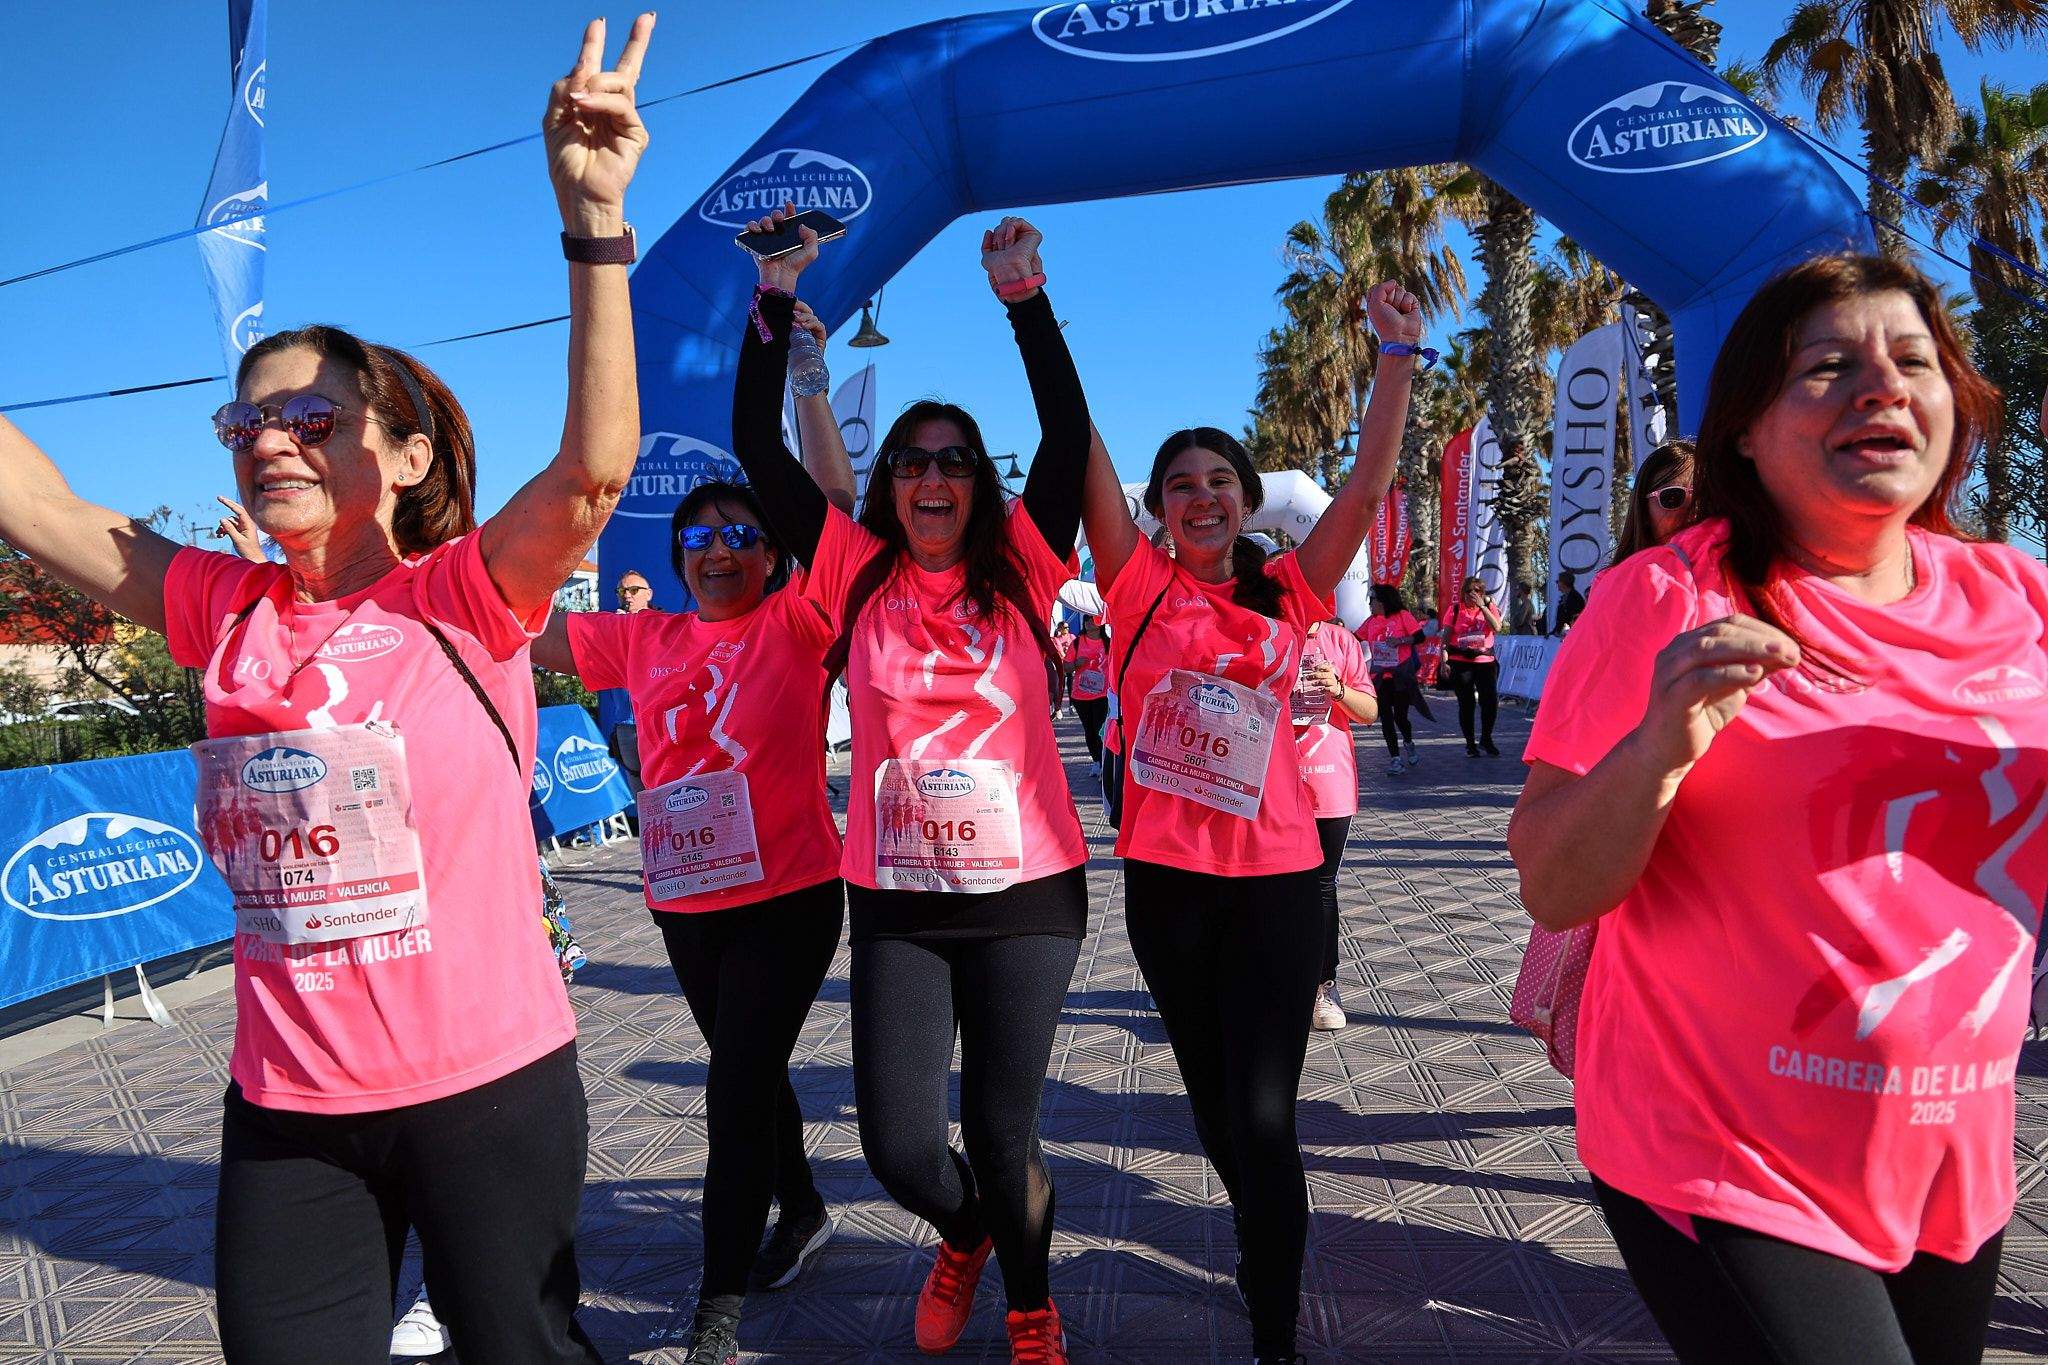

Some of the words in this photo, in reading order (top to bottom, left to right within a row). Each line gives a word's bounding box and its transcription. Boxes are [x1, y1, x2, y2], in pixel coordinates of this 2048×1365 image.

[1057, 0, 1303, 38] ASTUR
[1616, 109, 1682, 128] CENTRAL
[1688, 106, 1745, 117] LECHERA
[1584, 117, 1759, 160] ASTURIANA
[735, 173, 788, 190] CENTRAL
[793, 172, 852, 183] LECHERA
[707, 186, 859, 216] ASTURIANA
[1557, 366, 1611, 577] OYSHO
[1453, 451, 1472, 537] Santander
[321, 635, 397, 657] ASTURIANA
[1179, 726, 1231, 758] 016
[1183, 753, 1207, 768] 5601
[247, 765, 320, 784] ASTURIANA
[920, 779, 972, 791] ASTURIANA
[1140, 768, 1180, 788] OYSHO
[1147, 756, 1171, 770] CARRERA
[1171, 763, 1180, 771] DE
[1180, 765, 1189, 774] LA
[1189, 768, 1211, 781] MUJER
[1215, 776, 1245, 792] VALENCIA
[667, 794, 707, 809] ASTURIANA
[1202, 788, 1244, 808] Santander
[671, 826, 716, 852] 016
[922, 819, 977, 842] 016
[46, 846, 115, 868] CENTRAL
[117, 836, 178, 855] LECHERA
[260, 824, 341, 863] 016
[933, 847, 959, 857] 6143
[681, 852, 704, 864] 6145
[893, 858, 922, 867] CARRERA
[923, 859, 932, 867] DE
[944, 860, 966, 868] MUJER
[971, 860, 1004, 868] VALENCIA
[27, 849, 195, 907] ASTURIANA
[682, 866, 690, 874] LA
[709, 870, 748, 885] Santander
[892, 872, 937, 884] OYSHO
[962, 874, 1006, 886] Santander
[265, 894, 276, 905] DE
[290, 889, 327, 904] MUJER
[336, 881, 391, 898] VALENCIA
[656, 880, 686, 895] OYSHO
[324, 905, 399, 928] Santander
[325, 940, 351, 966] LA
[352, 928, 433, 965] MUJER
[294, 971, 335, 993] 2025
[1768, 1044, 1901, 1095] CARRERA
[1910, 1065, 1946, 1097] DE
[1950, 1063, 1977, 1095] LA
[1909, 1100, 1957, 1125] 2025
